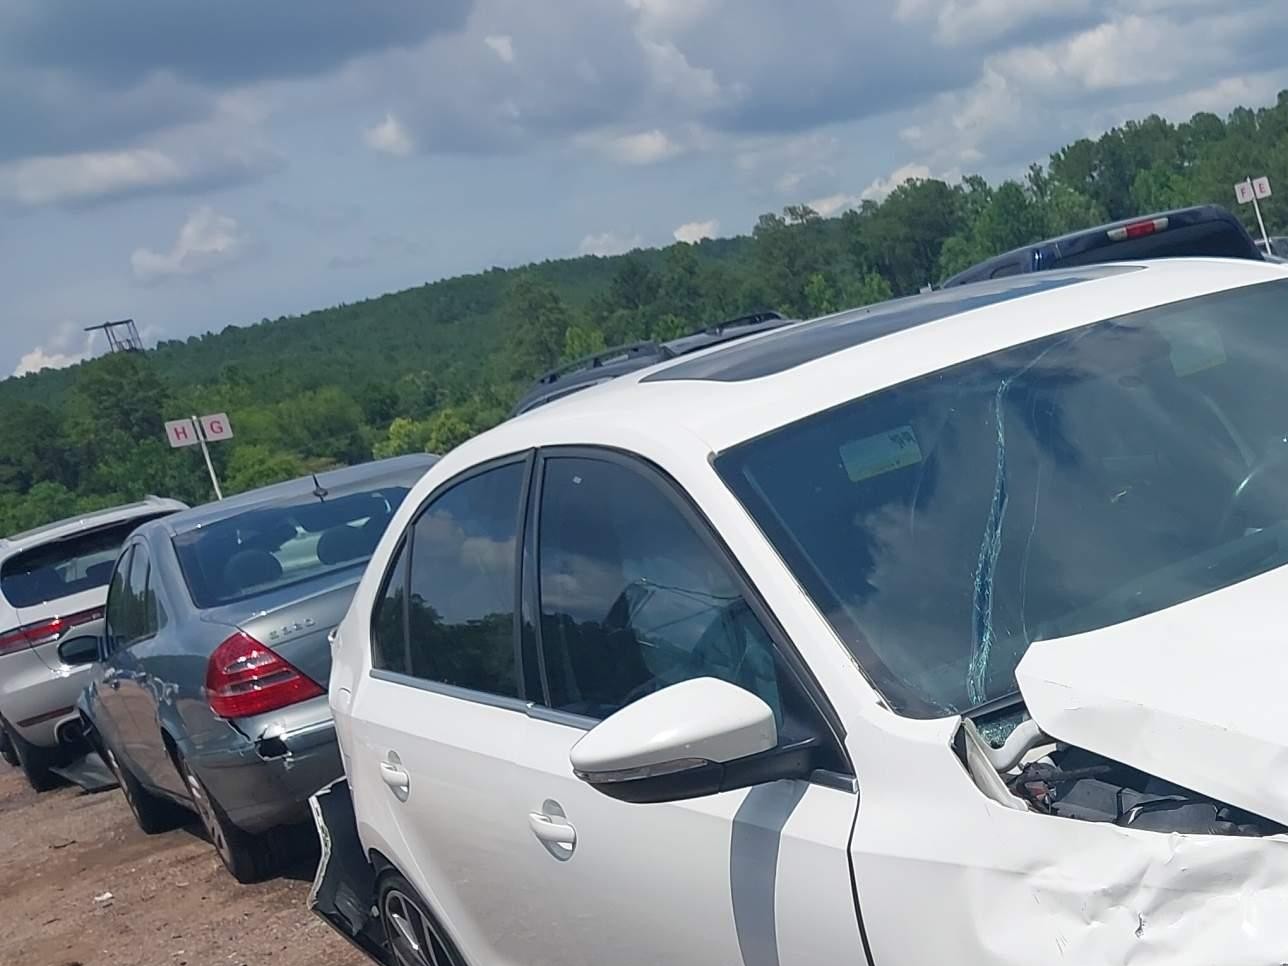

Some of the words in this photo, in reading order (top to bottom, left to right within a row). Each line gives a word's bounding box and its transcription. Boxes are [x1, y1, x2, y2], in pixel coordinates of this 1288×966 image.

[1258, 183, 1266, 194] E
[173, 426, 188, 441] H
[209, 420, 224, 434] G
